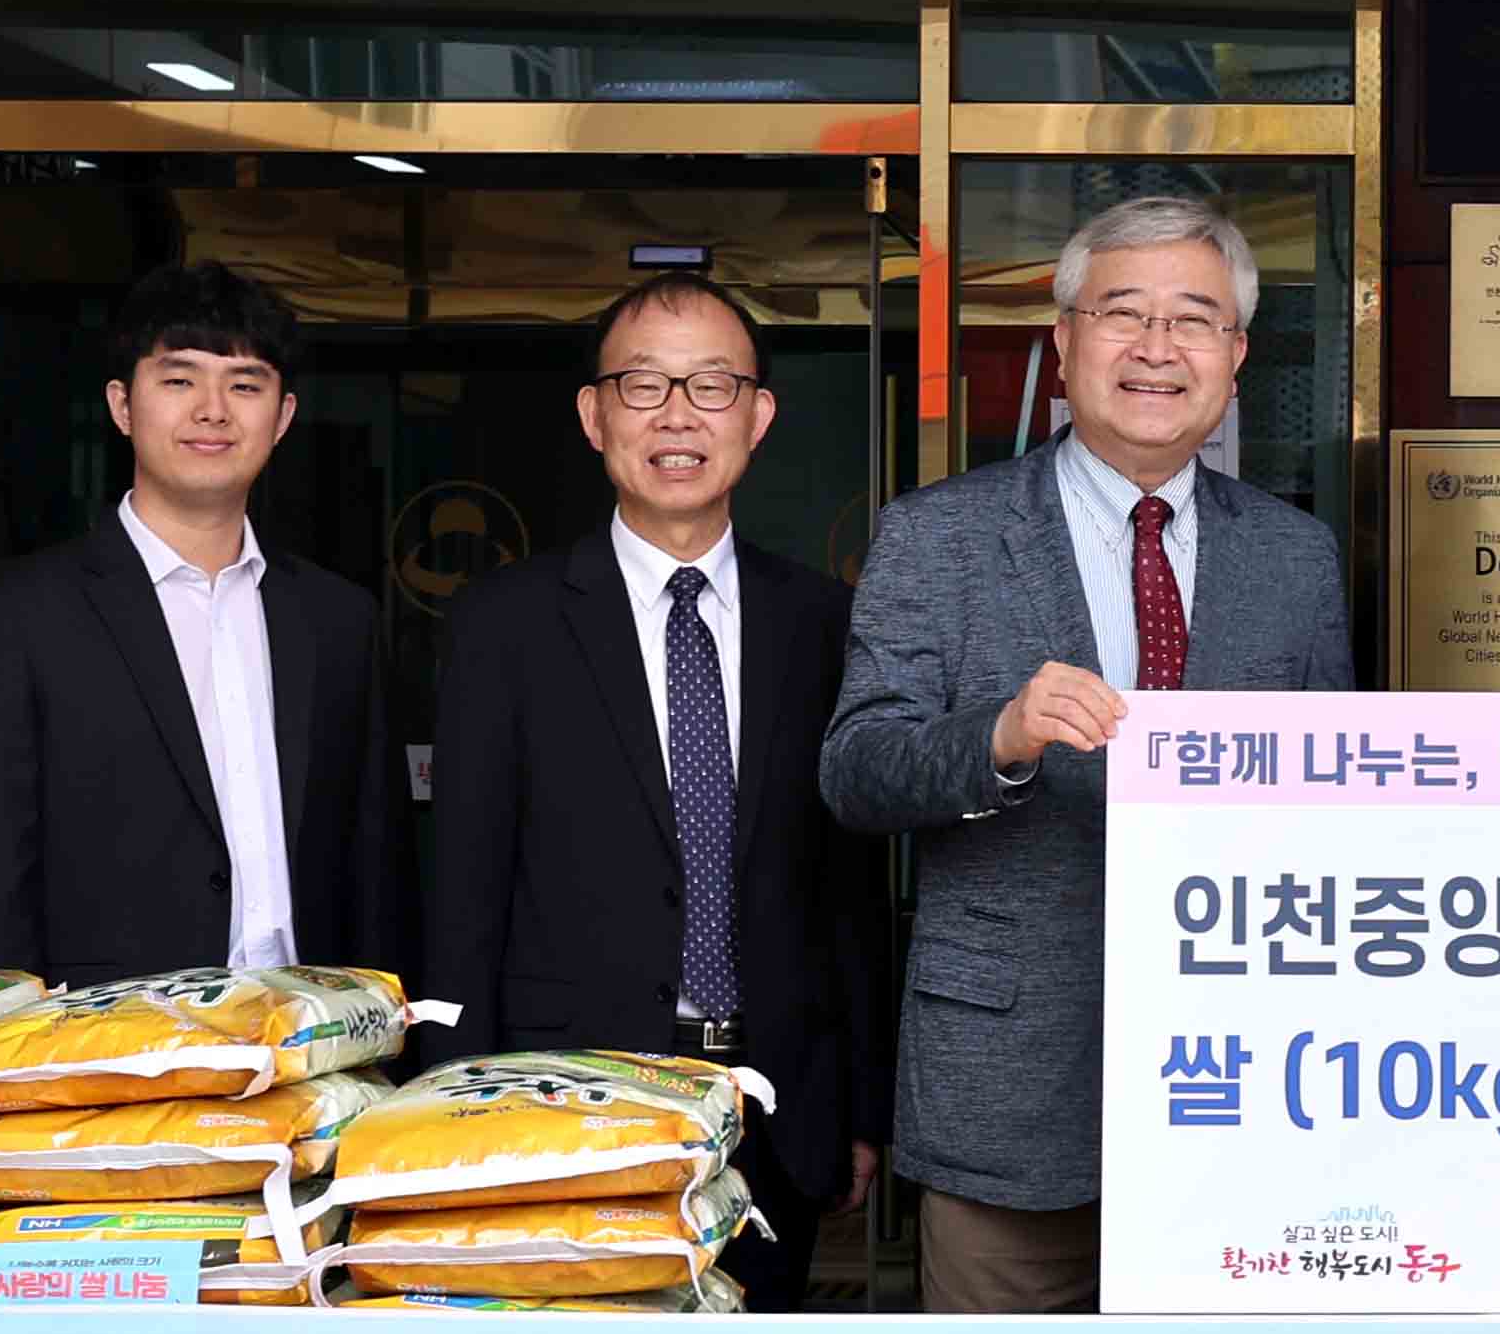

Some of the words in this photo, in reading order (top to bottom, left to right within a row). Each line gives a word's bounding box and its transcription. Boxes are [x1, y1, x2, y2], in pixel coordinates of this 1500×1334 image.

[1463, 474, 1494, 485] World
[1482, 593, 1492, 604] is
[1453, 610, 1489, 624] World
[1438, 630, 1481, 643] Global
[1149, 731, 1278, 785] 『함께
[1304, 733, 1477, 790] 나누는,
[1161, 1035, 1252, 1126] 쌀
[28, 1219, 61, 1229] NH
[1284, 1225, 1316, 1243] 살고
[1321, 1225, 1354, 1244] 싶은
[1221, 1246, 1294, 1278] 활기찬
[1299, 1249, 1391, 1279] 행복도시
[1395, 1245, 1460, 1283] 동구
[79, 1272, 108, 1299] 쌀
[114, 1272, 169, 1300] 나눔
